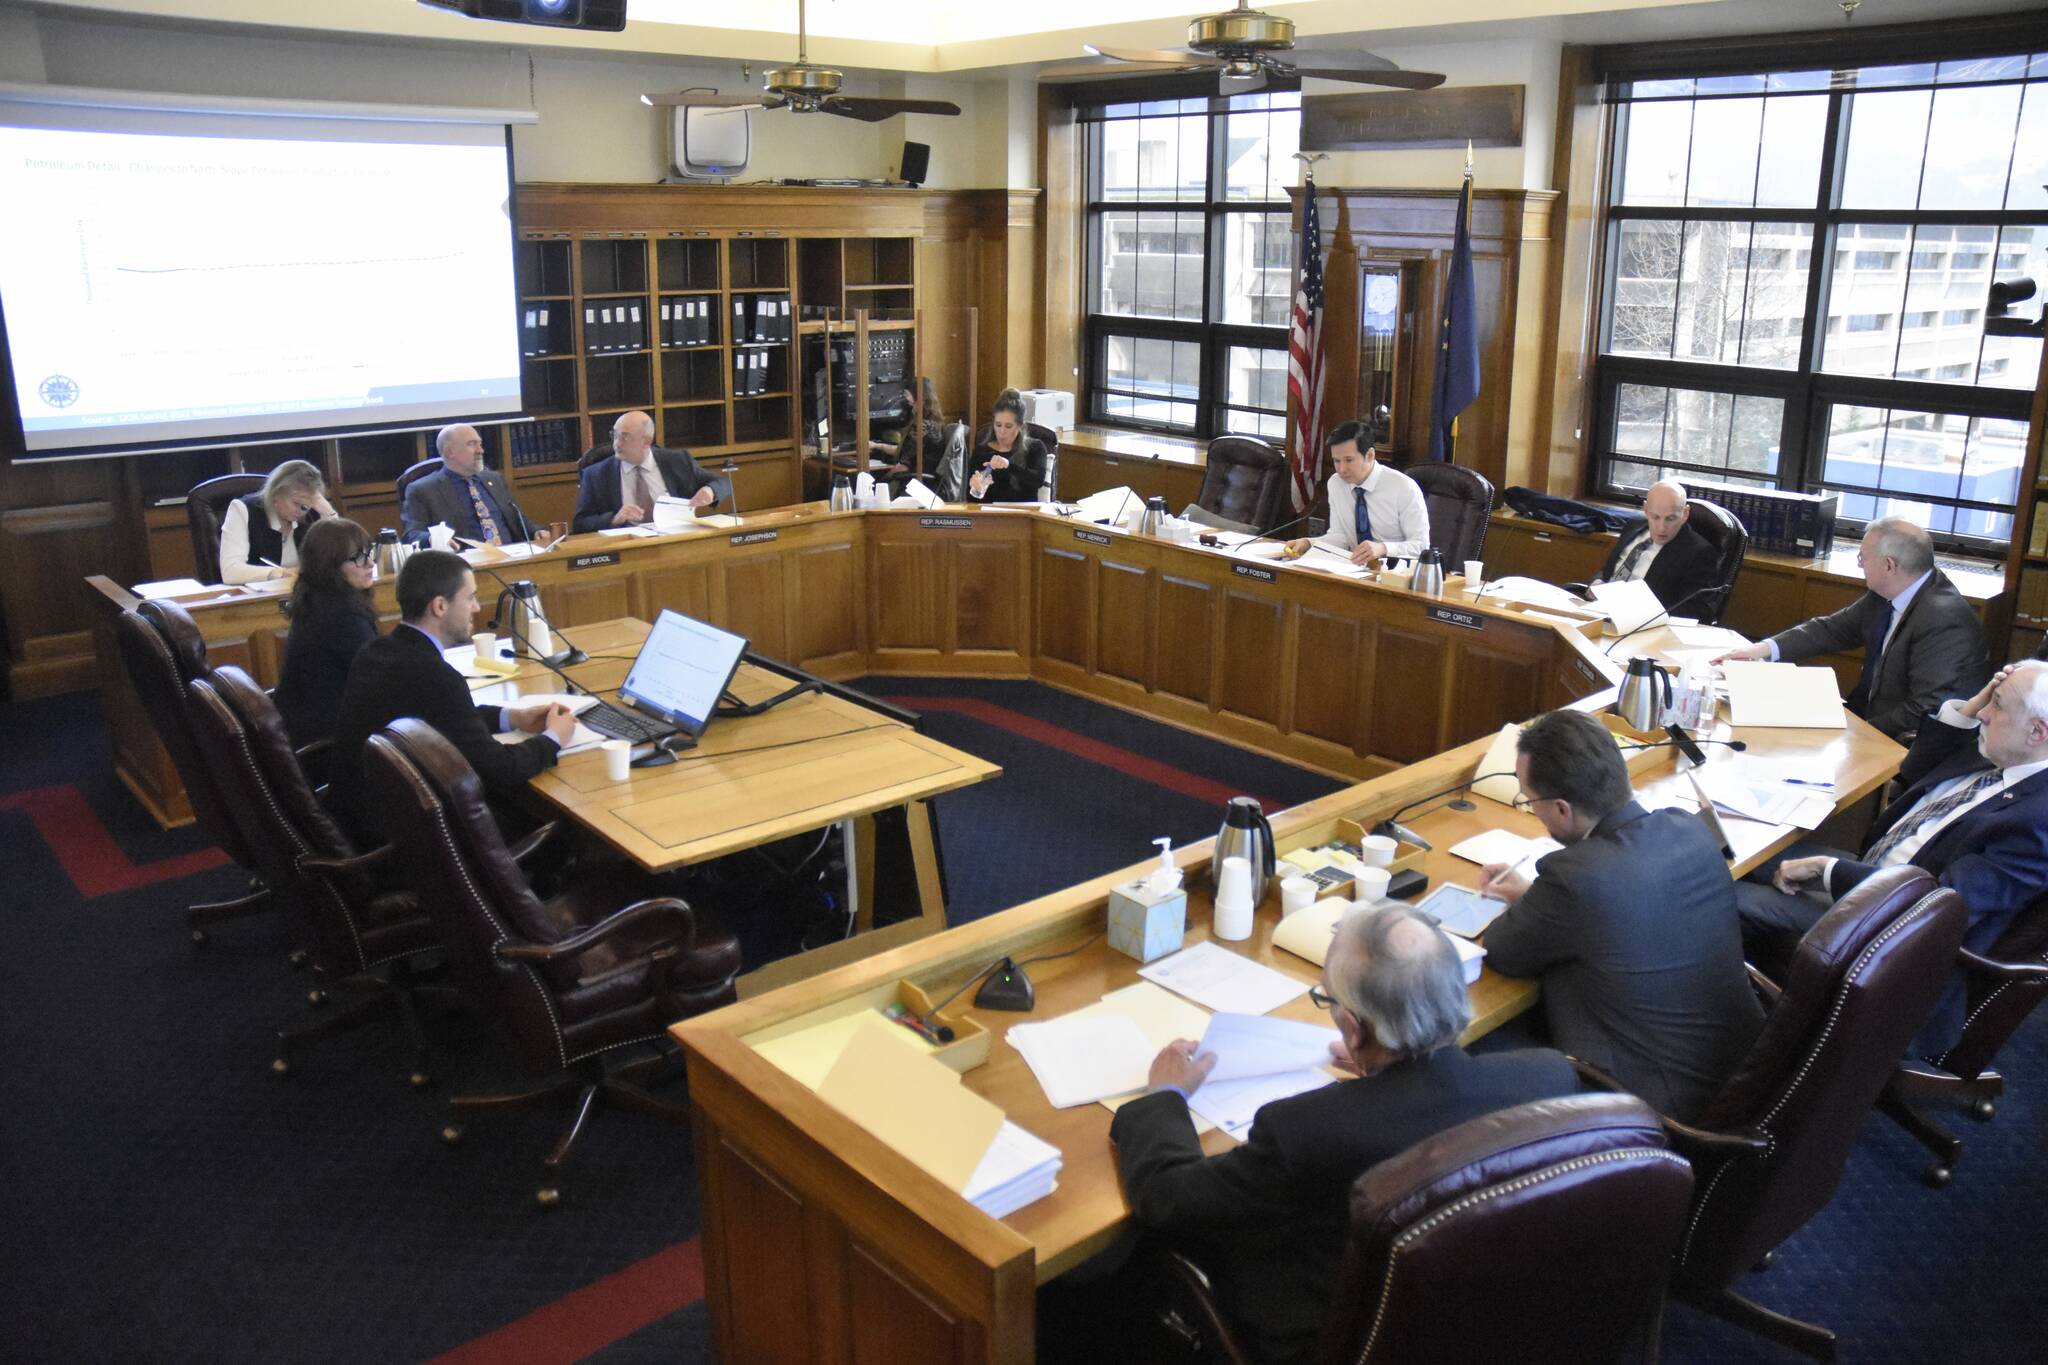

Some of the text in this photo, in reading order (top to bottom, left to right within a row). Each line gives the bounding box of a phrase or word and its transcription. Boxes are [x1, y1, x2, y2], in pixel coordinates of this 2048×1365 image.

[744, 531, 777, 541] JOSEPHSON
[577, 555, 611, 566] REP. WOOL
[1249, 569, 1271, 579] FOSTER
[1437, 610, 1473, 624] REP. ORTIZ
